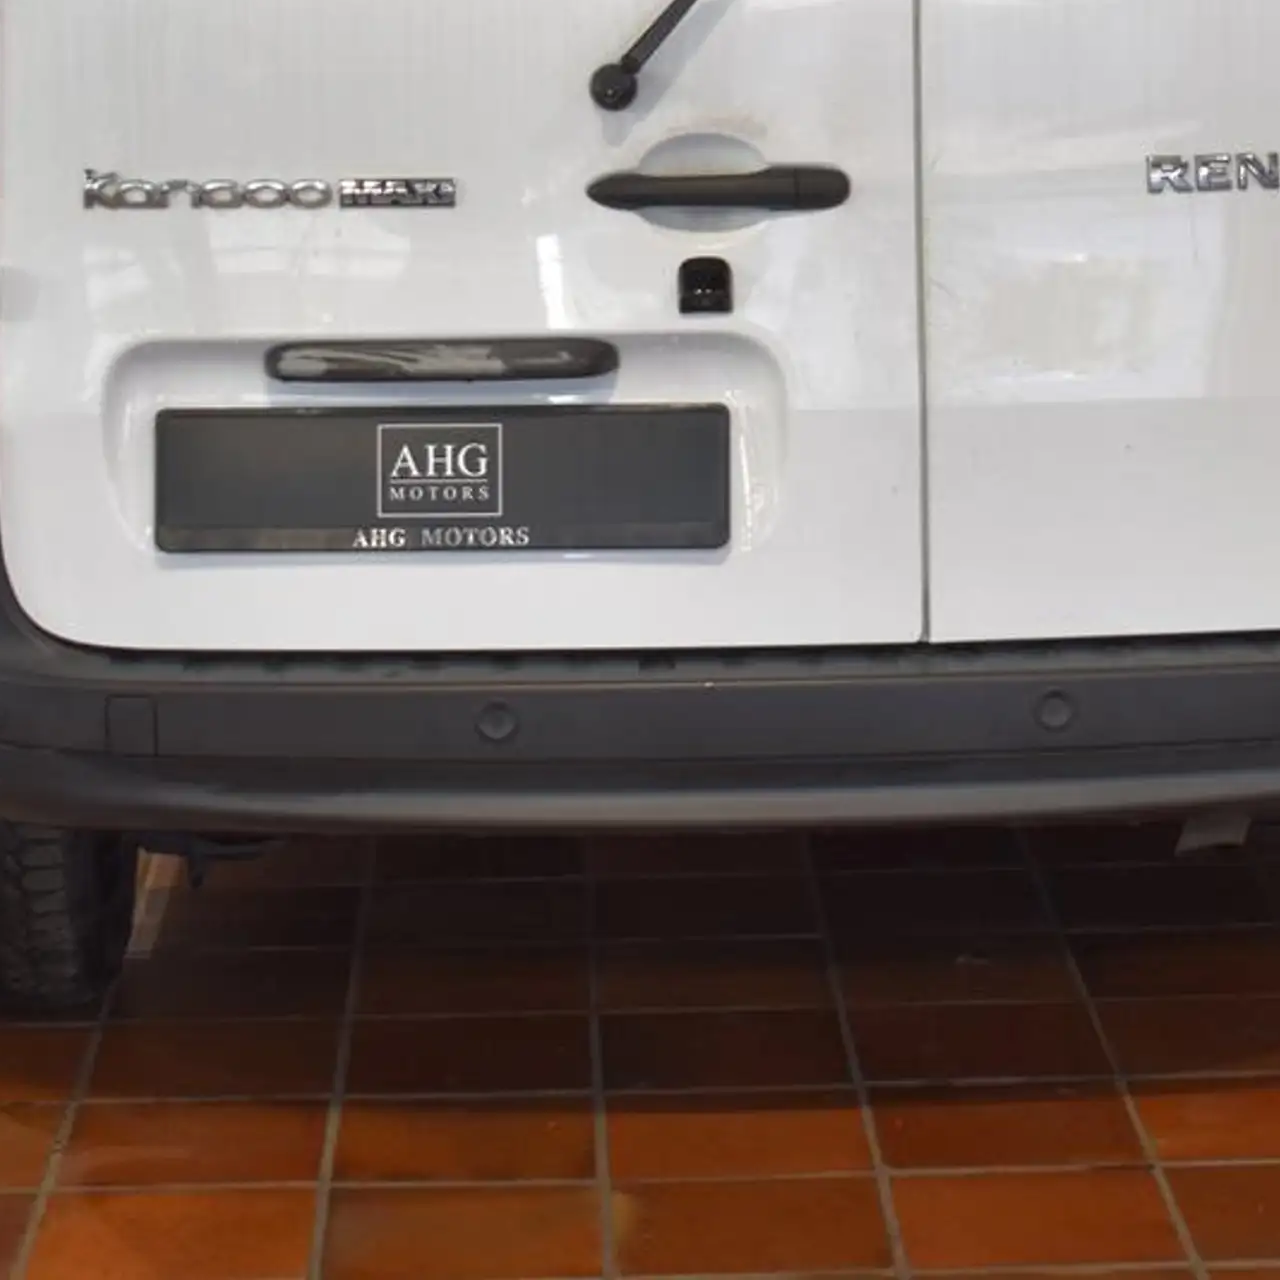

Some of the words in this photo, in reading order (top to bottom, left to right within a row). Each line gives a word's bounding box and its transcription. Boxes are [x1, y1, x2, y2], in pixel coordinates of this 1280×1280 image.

[390, 443, 488, 477] AHG
[389, 486, 490, 501] MOTORS
[352, 527, 406, 548] AHG
[421, 526, 531, 546] MOTORS
